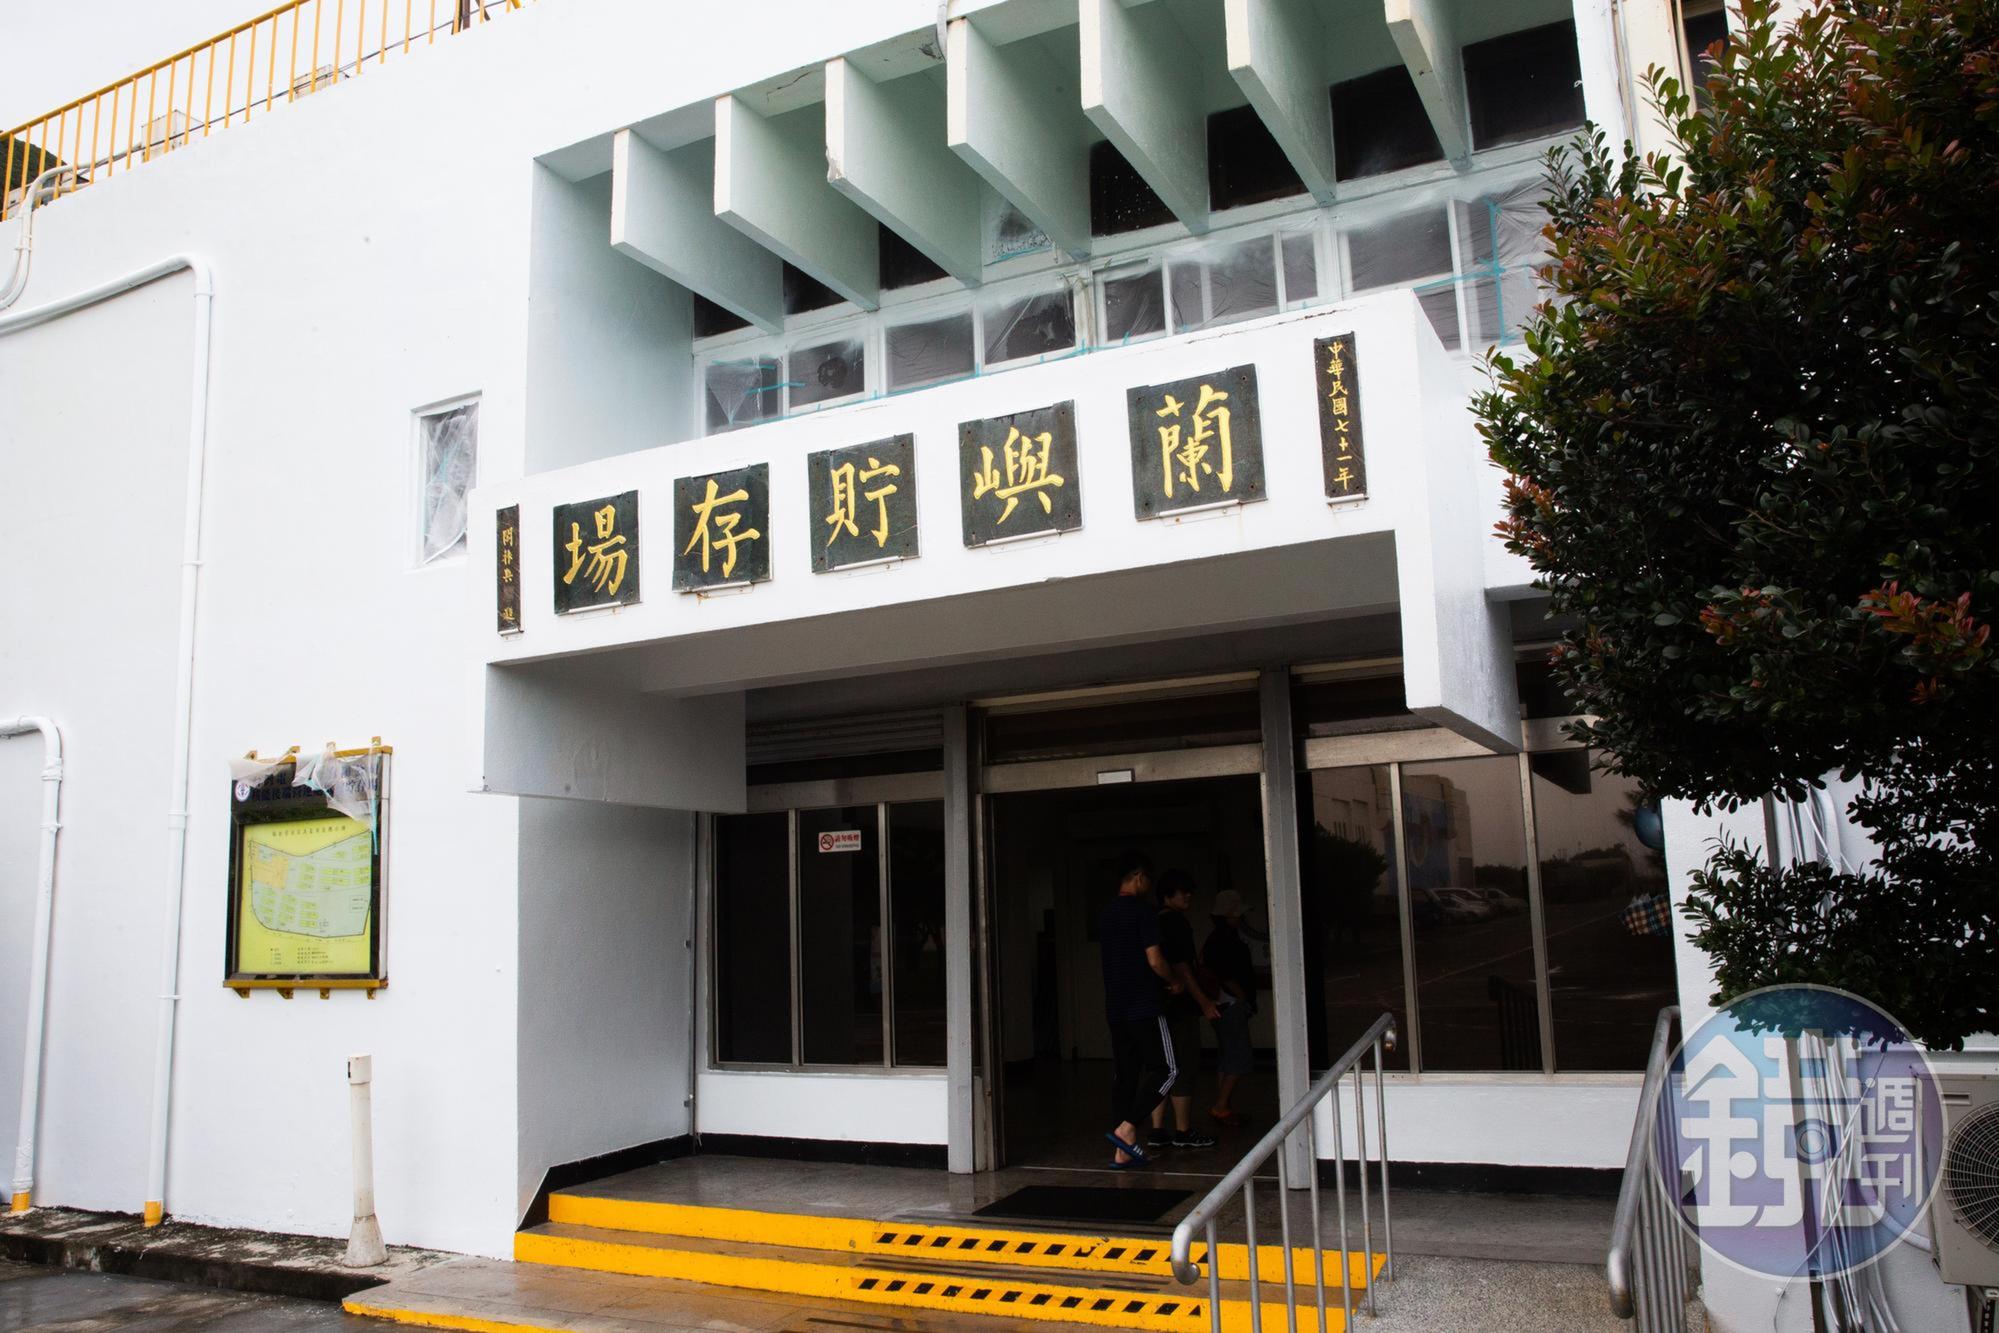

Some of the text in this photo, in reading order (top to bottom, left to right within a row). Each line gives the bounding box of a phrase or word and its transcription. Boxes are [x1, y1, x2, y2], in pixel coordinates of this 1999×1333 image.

[564, 385, 1232, 594] 蘭嶼貯存場
[1327, 341, 1354, 490] 中華民國七十一年
